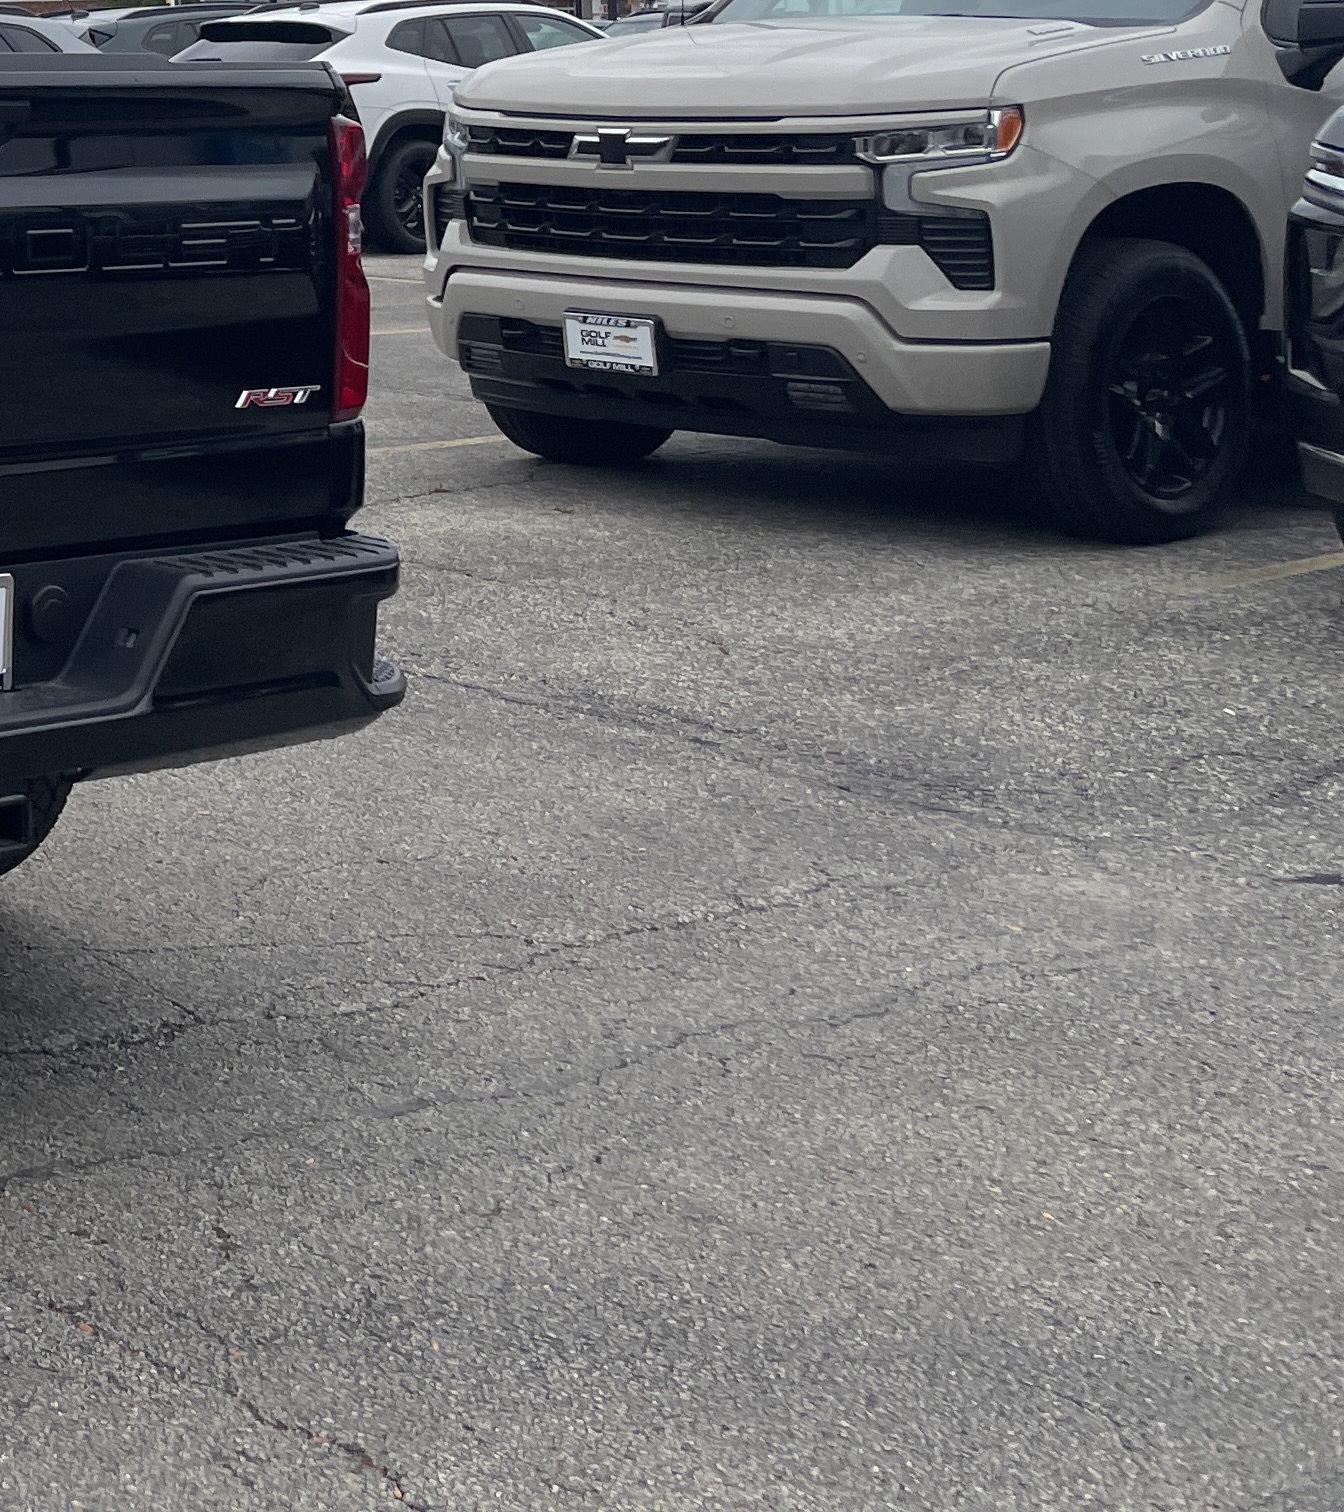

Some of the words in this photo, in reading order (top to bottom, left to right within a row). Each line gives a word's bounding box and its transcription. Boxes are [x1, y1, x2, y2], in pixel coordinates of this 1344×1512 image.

[1140, 44, 1231, 65] SILVERADO
[585, 316, 628, 327] NILES
[580, 329, 612, 339] GOLF
[581, 338, 608, 348] MILL
[587, 360, 612, 369] GOLF
[612, 363, 635, 373] MILL
[234, 385, 321, 408] RST
